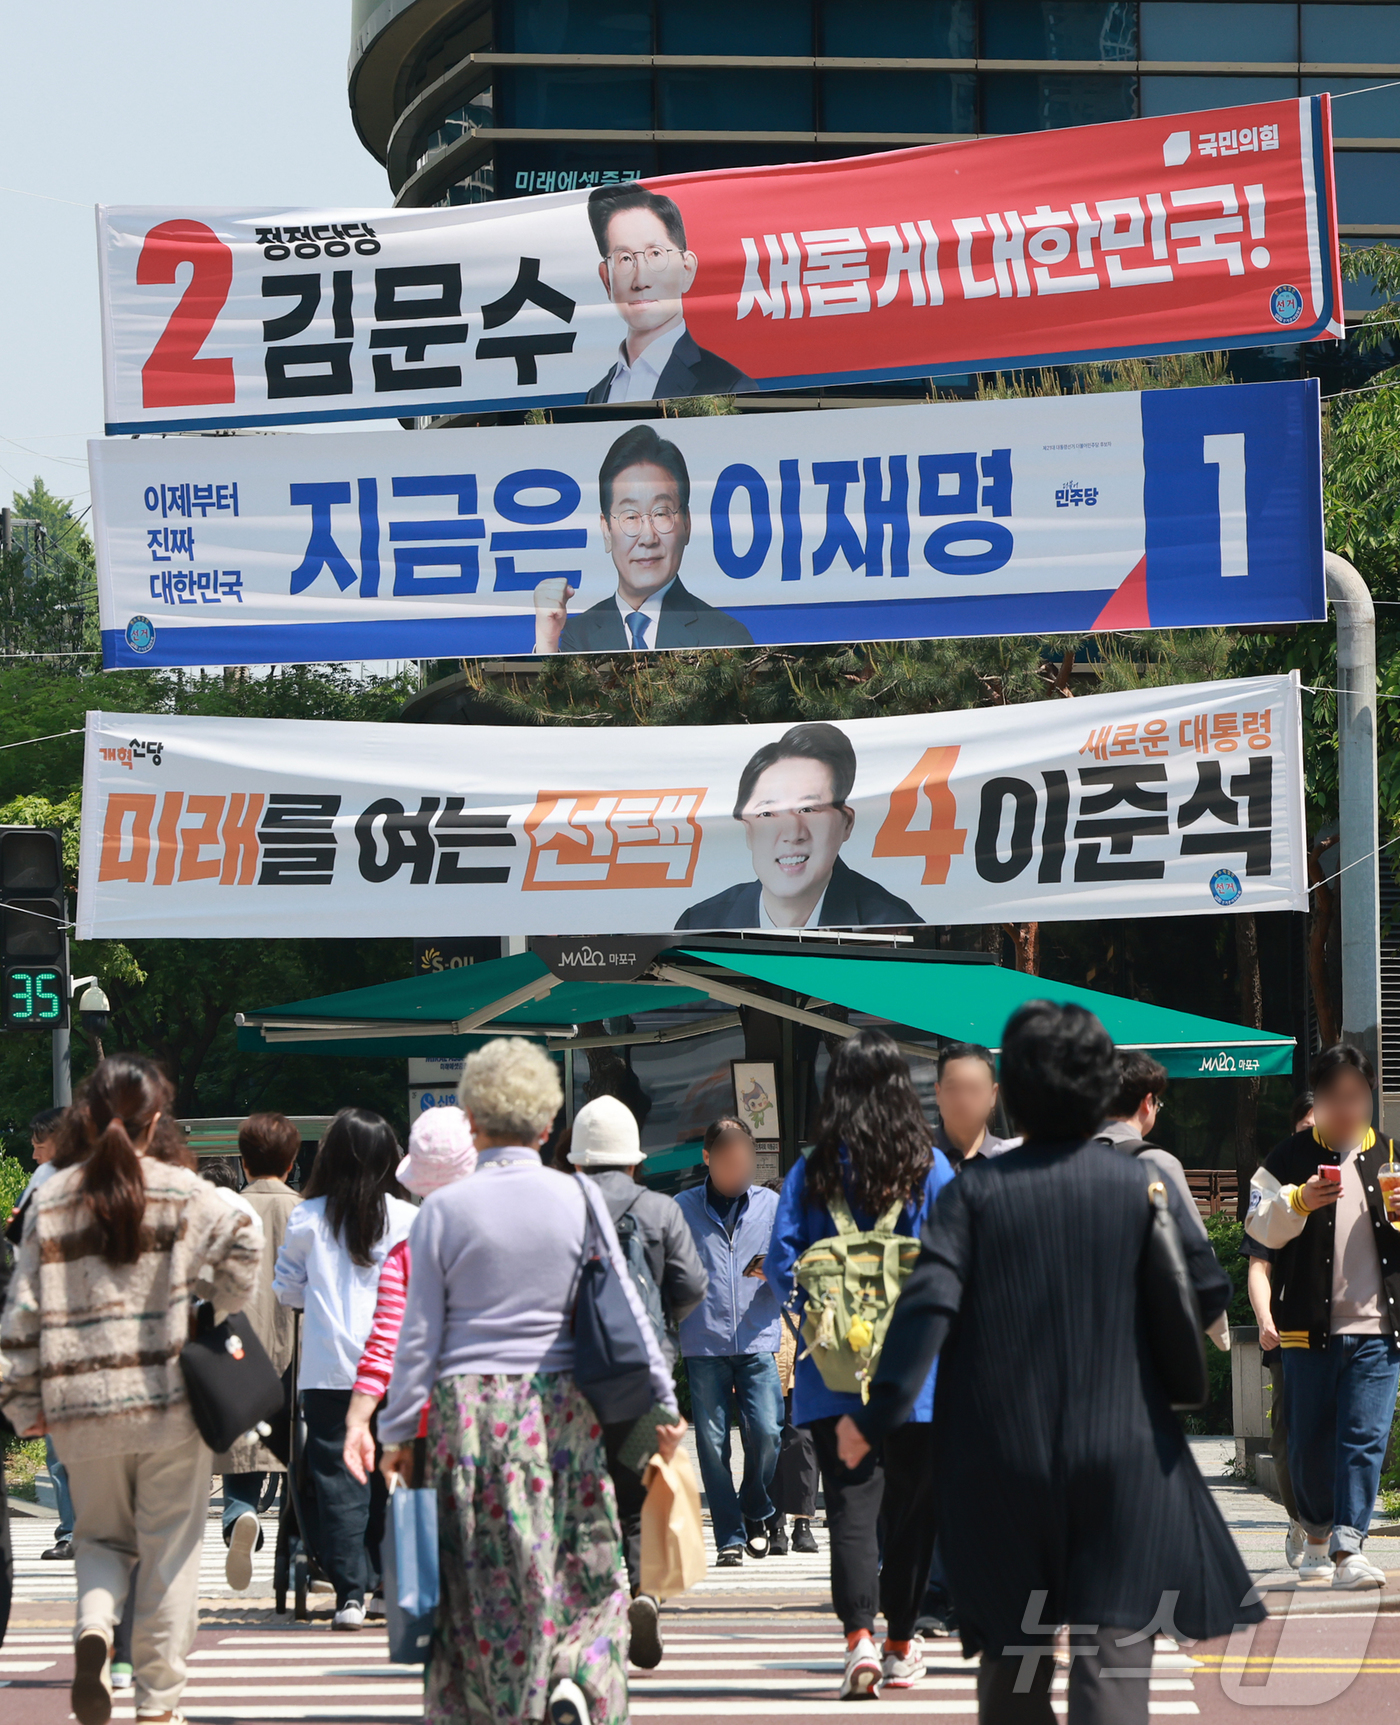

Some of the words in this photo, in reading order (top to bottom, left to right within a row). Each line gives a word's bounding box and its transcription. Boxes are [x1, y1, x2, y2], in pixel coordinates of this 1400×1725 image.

[1197, 123, 1279, 158] 국민의힘
[255, 222, 381, 262] 정정당당
[737, 219, 944, 320] 새롭게
[952, 183, 1271, 298] 대한민국!
[136, 219, 235, 408] 2
[262, 257, 577, 400] 김문수
[144, 482, 239, 518] 이제부터
[1055, 487, 1099, 508] 민주당
[1203, 432, 1249, 577] 1
[290, 468, 588, 597] 지금은
[711, 448, 1014, 581] 이재명
[147, 526, 195, 562] 진짜
[150, 569, 244, 604] 대한민국
[99, 738, 164, 770] 개혁신당
[1079, 719, 1170, 760] 새로운
[1179, 708, 1272, 754] 대통령
[99, 792, 341, 886] 미래를
[355, 796, 517, 885] 여는
[524, 788, 707, 890] 선택
[872, 745, 968, 885] 4
[975, 756, 1272, 885] 이준석
[609, 953, 637, 966] 마포구
[11, 973, 59, 1018] 35
[1238, 1059, 1260, 1071] 마포구
